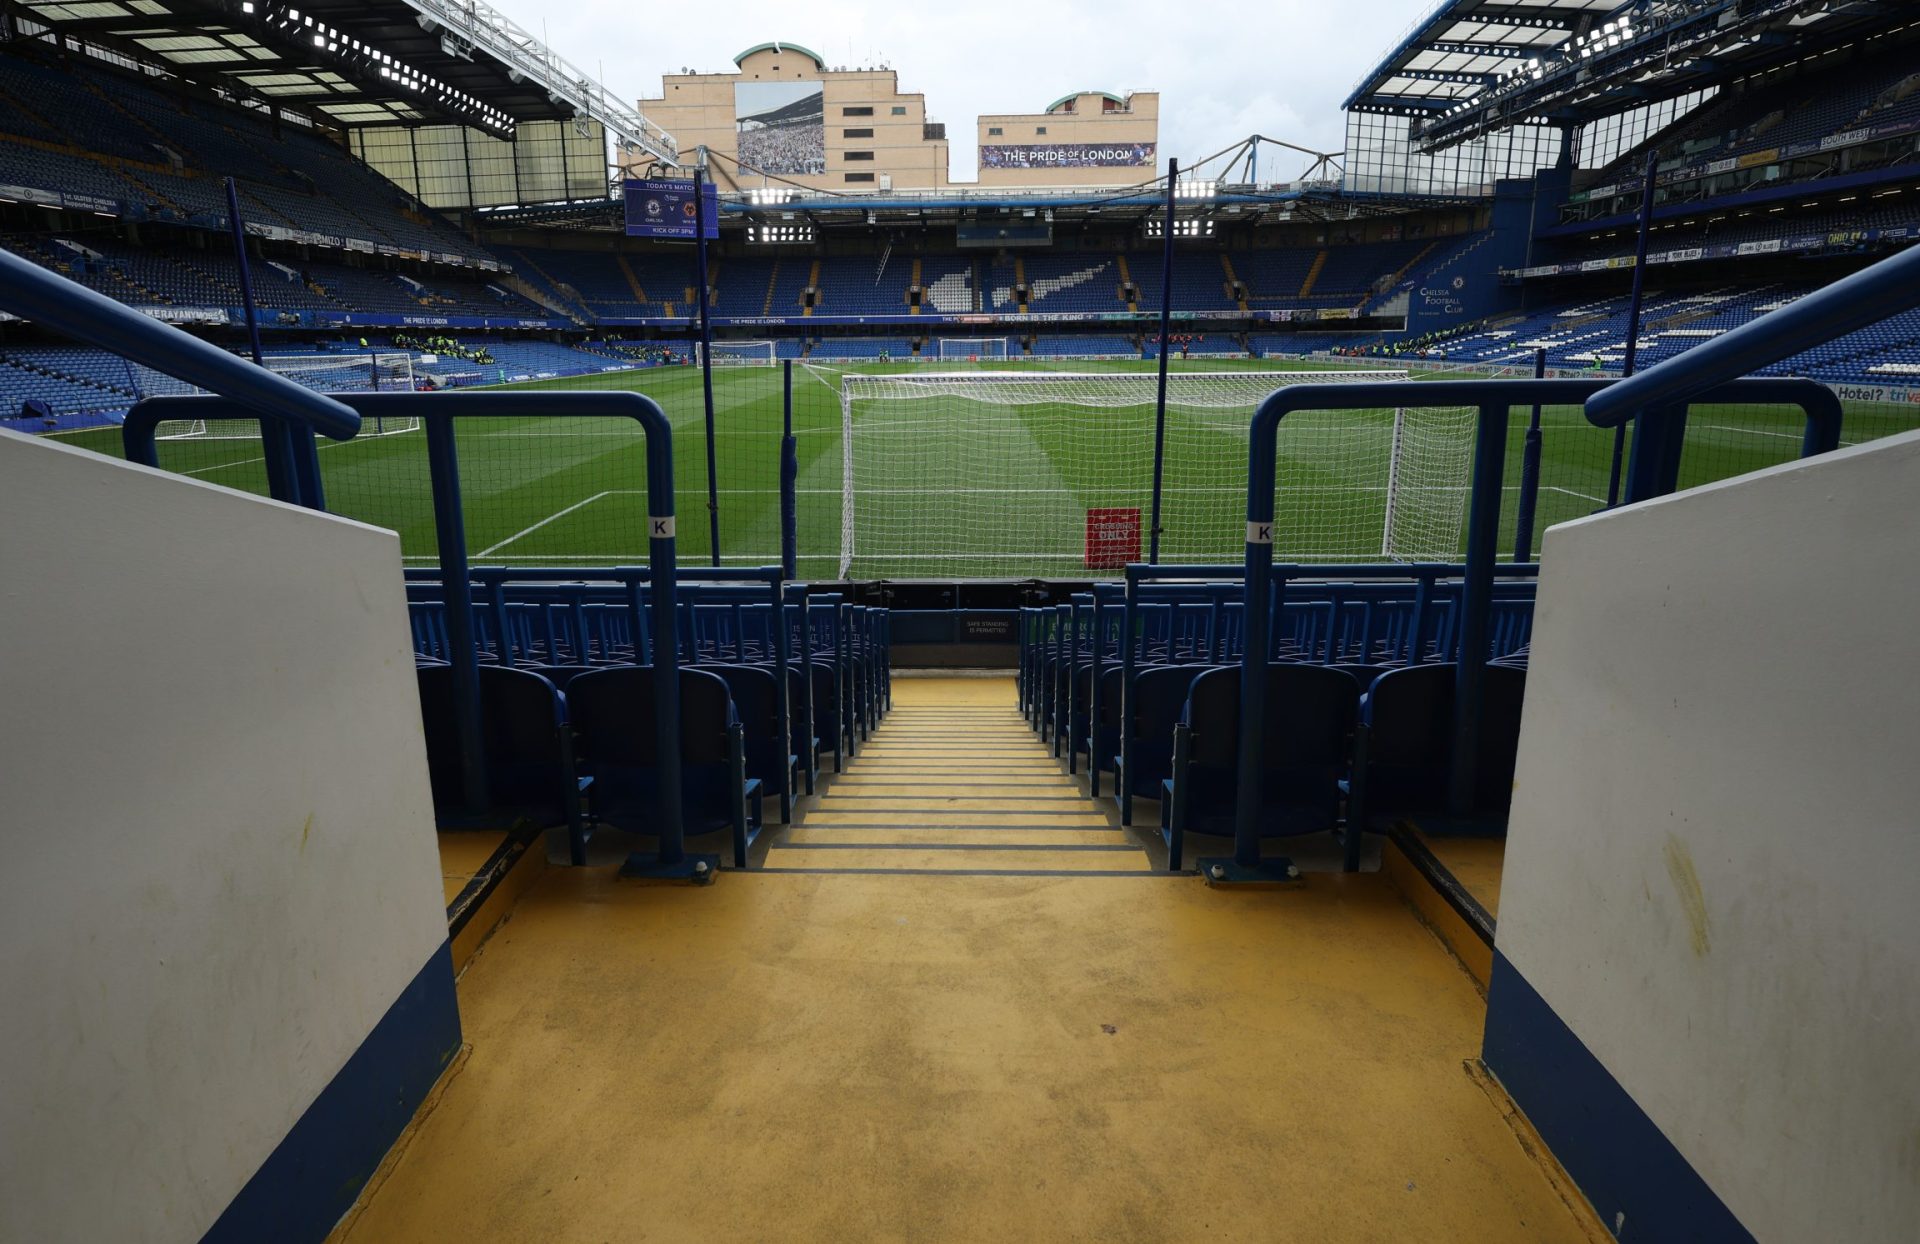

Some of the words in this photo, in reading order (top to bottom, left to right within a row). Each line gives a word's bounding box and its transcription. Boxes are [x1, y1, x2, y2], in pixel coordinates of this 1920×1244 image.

[1822, 135, 1847, 146] SOUTH
[1848, 129, 1869, 140] WEST
[1004, 151, 1026, 162] THE
[1030, 151, 1065, 161] PRIDE
[1068, 150, 1079, 160] OF
[1082, 150, 1132, 160] LONDON
[645, 182, 672, 190] TODAY'S
[1828, 232, 1848, 244] OHIO
[1420, 287, 1450, 296] CHELSEA
[1425, 296, 1460, 305] FOOTBALL
[1444, 305, 1464, 313] CLUB
[431, 317, 448, 325] LONDON
[1004, 314, 1028, 322] BORN
[1062, 313, 1083, 321] KING
[1838, 387, 1883, 401] Hotel?
[654, 520, 666, 534] K
[1099, 531, 1129, 539] ONLY
[1259, 526, 1270, 540] K
